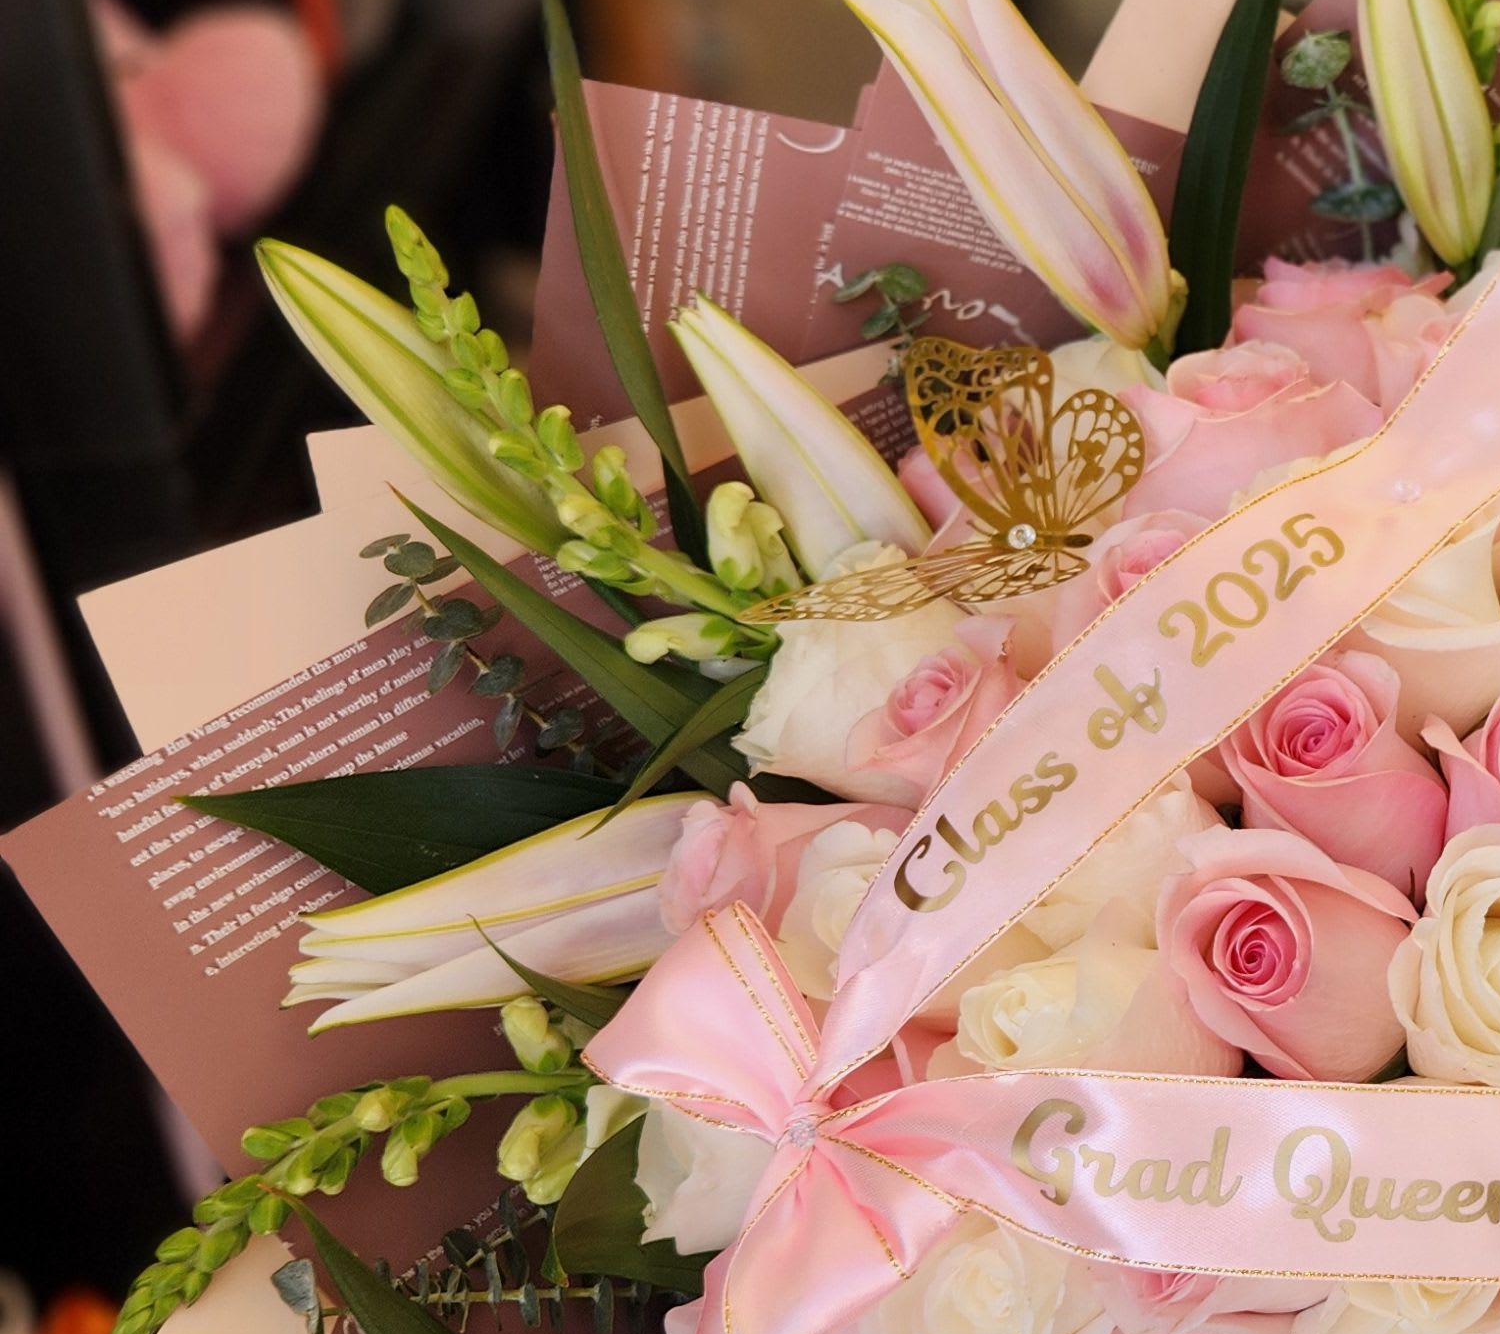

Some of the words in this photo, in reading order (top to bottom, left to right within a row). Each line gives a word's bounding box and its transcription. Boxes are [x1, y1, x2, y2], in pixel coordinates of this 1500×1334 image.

[189, 748, 225, 771] when
[301, 679, 348, 710] feelings
[347, 669, 362, 685] of
[361, 658, 388, 678] men
[386, 645, 412, 666] play
[309, 657, 332, 676] the
[329, 636, 368, 666] movie
[209, 774, 225, 791] of
[276, 732, 306, 753] man
[316, 712, 339, 731] not
[337, 691, 378, 718] worthy
[379, 680, 393, 695] of
[354, 750, 375, 767] the
[372, 731, 409, 756] house
[895, 751, 1077, 913] Class
[1087, 663, 1168, 750] of
[1158, 513, 1346, 668] 2025
[170, 824, 196, 844] two
[337, 719, 381, 747] woman
[1010, 1098, 1241, 1208] Grad
